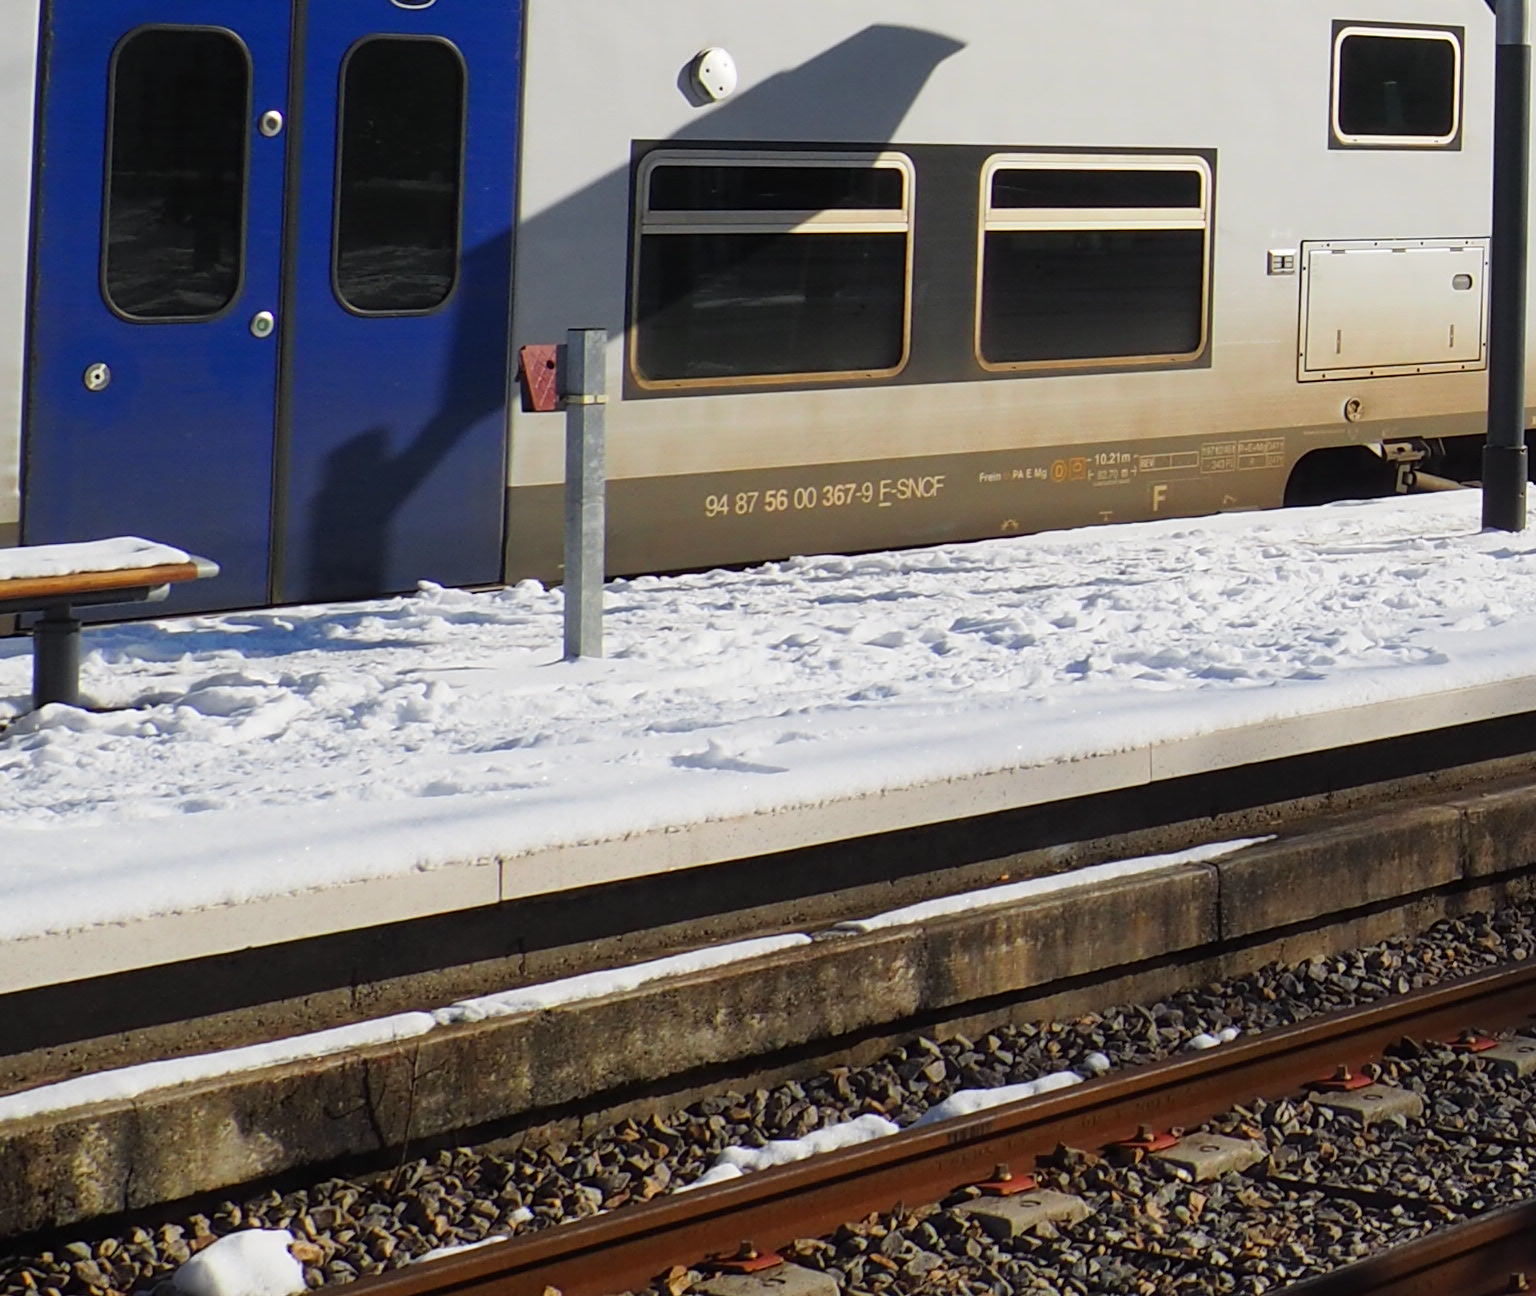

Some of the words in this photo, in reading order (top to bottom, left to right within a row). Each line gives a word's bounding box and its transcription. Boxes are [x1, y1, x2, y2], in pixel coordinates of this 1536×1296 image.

[705, 495, 729, 518] 94
[735, 492, 759, 515] 87
[764, 488, 789, 512] 56
[793, 486, 817, 510] 00
[822, 482, 873, 507] 367-9
[878, 475, 946, 508] F-SNCF
[1152, 484, 1168, 512] F
